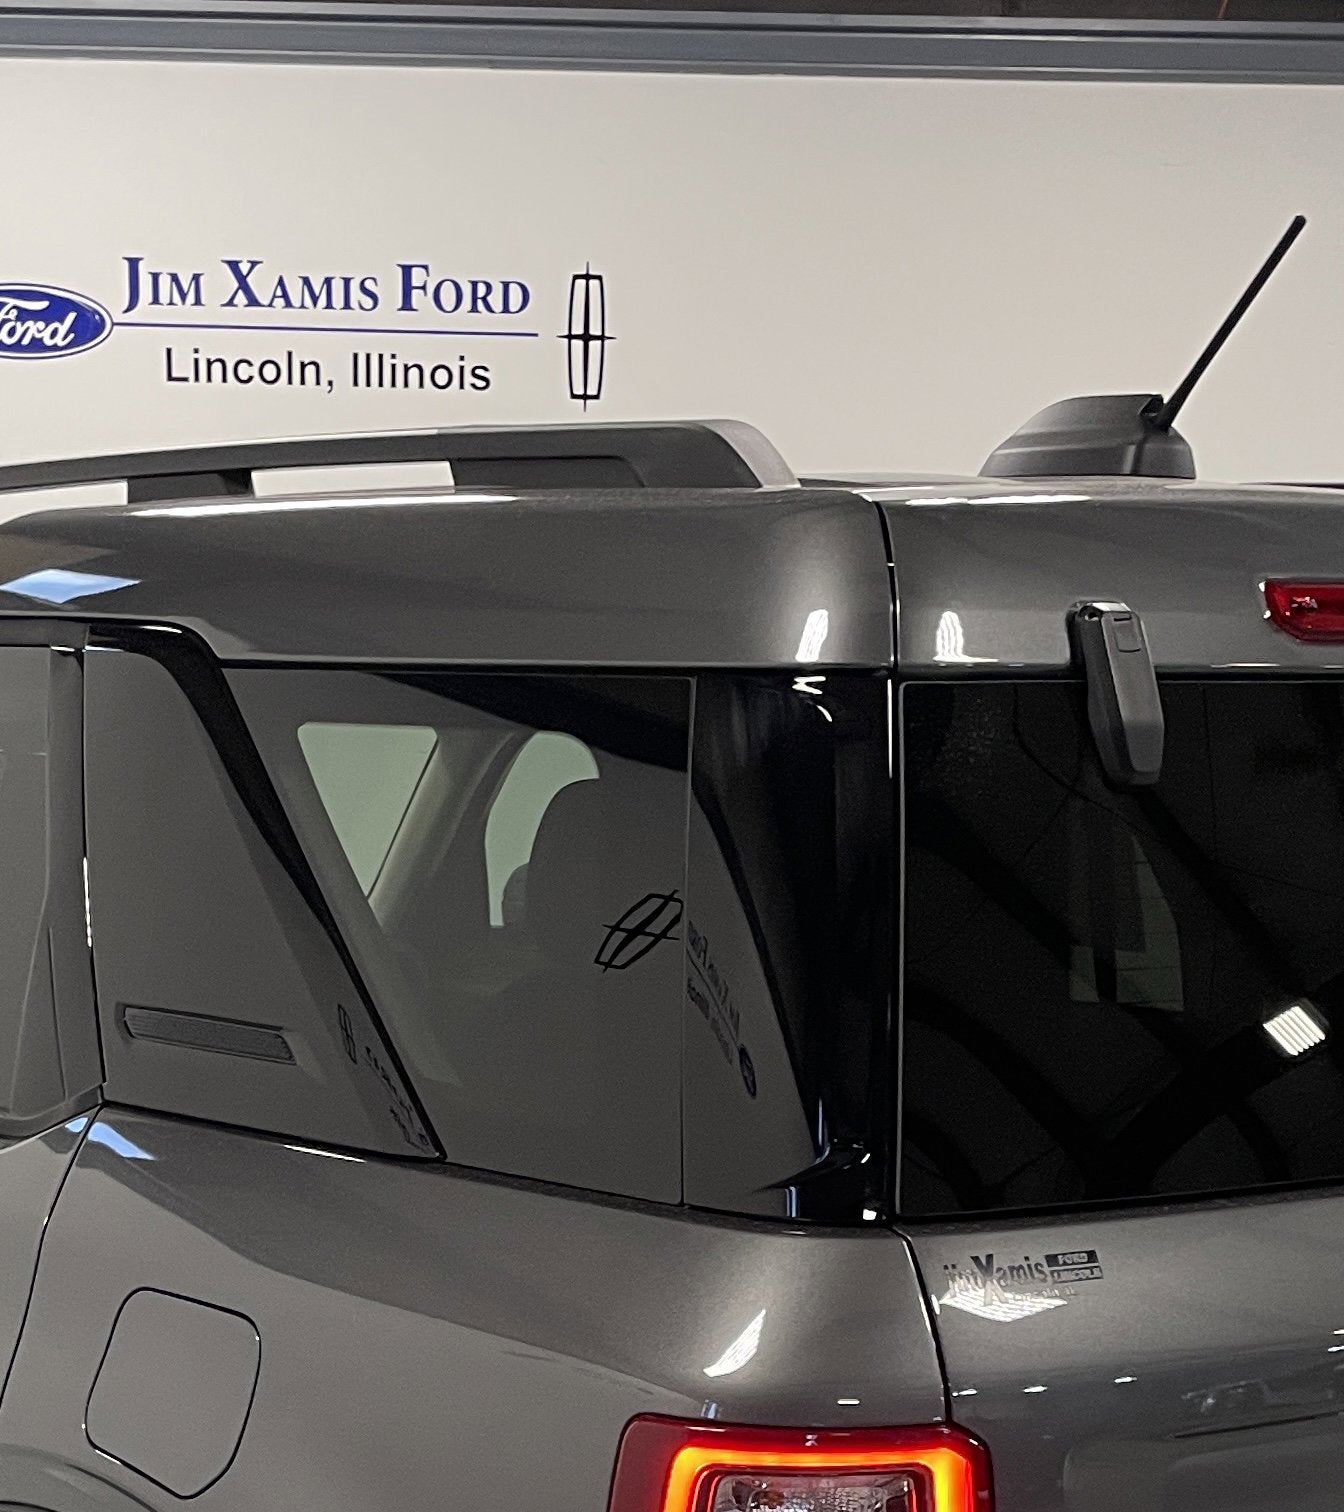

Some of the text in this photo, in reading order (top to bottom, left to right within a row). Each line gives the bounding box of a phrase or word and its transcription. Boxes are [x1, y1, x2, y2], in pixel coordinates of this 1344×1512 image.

[120, 256, 531, 316] JIM XAMIS FORD
[164, 346, 492, 393] Lincoln, Illinois
